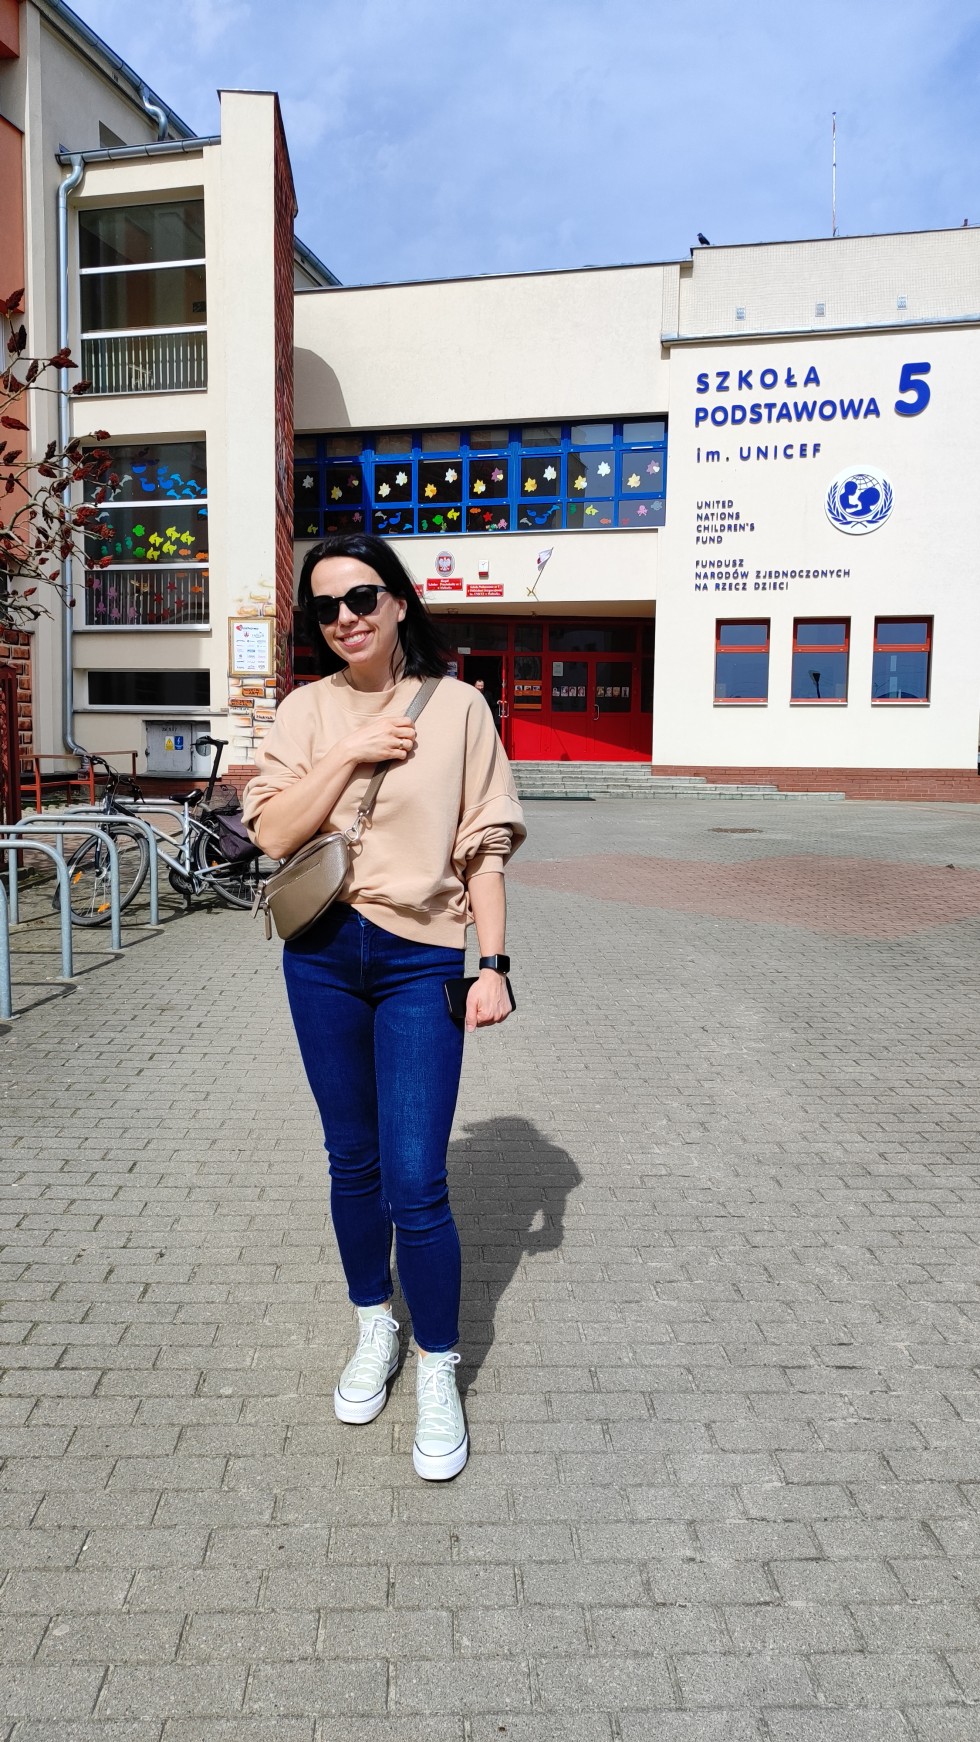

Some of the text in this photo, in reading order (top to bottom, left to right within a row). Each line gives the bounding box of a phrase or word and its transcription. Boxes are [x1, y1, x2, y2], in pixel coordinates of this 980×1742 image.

[696, 365, 821, 394] SZKOŁA
[893, 361, 932, 417] 5
[694, 396, 881, 428] PODSTAWOWA
[696, 443, 822, 463] im. UNICEF
[696, 499, 734, 511] UNITED
[696, 511, 741, 521] NATIONS
[696, 522, 755, 533] CHILDREN'S
[695, 535, 723, 544] FUND
[695, 559, 744, 569] FUNDUSZ
[695, 569, 851, 580] NARODÓW ZJEDNOCZONYCH
[694, 582, 789, 591] NA RZECZ DZIECI
